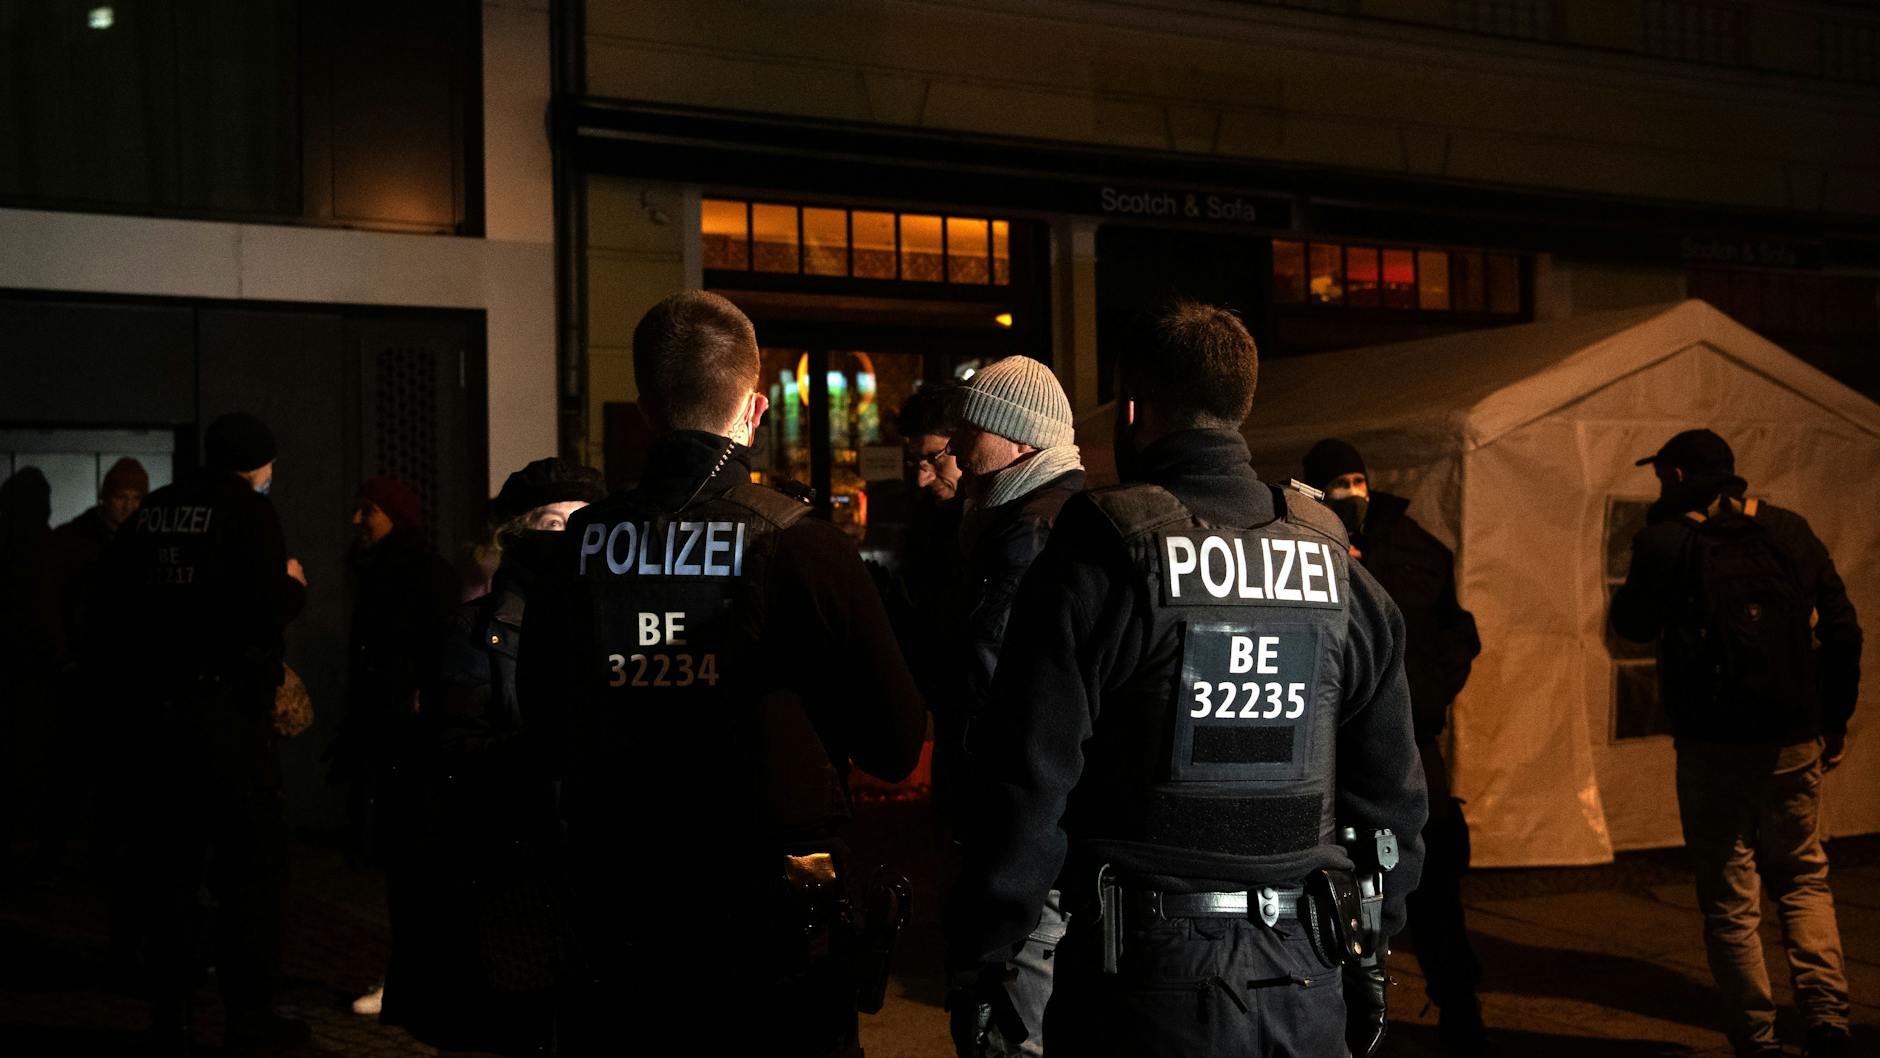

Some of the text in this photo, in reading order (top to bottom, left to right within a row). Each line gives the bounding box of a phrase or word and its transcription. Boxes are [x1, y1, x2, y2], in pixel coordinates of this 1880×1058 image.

[1100, 187, 1257, 222] Scotch & Sofa
[136, 505, 213, 534] POLIZEI
[159, 546, 181, 564] BE
[579, 521, 745, 576] POLIZEI
[1166, 535, 1339, 603] POLIZEI
[638, 612, 687, 646] BE
[608, 653, 719, 687] 32234
[1229, 636, 1280, 674] BE
[1190, 681, 1305, 719] 32235
